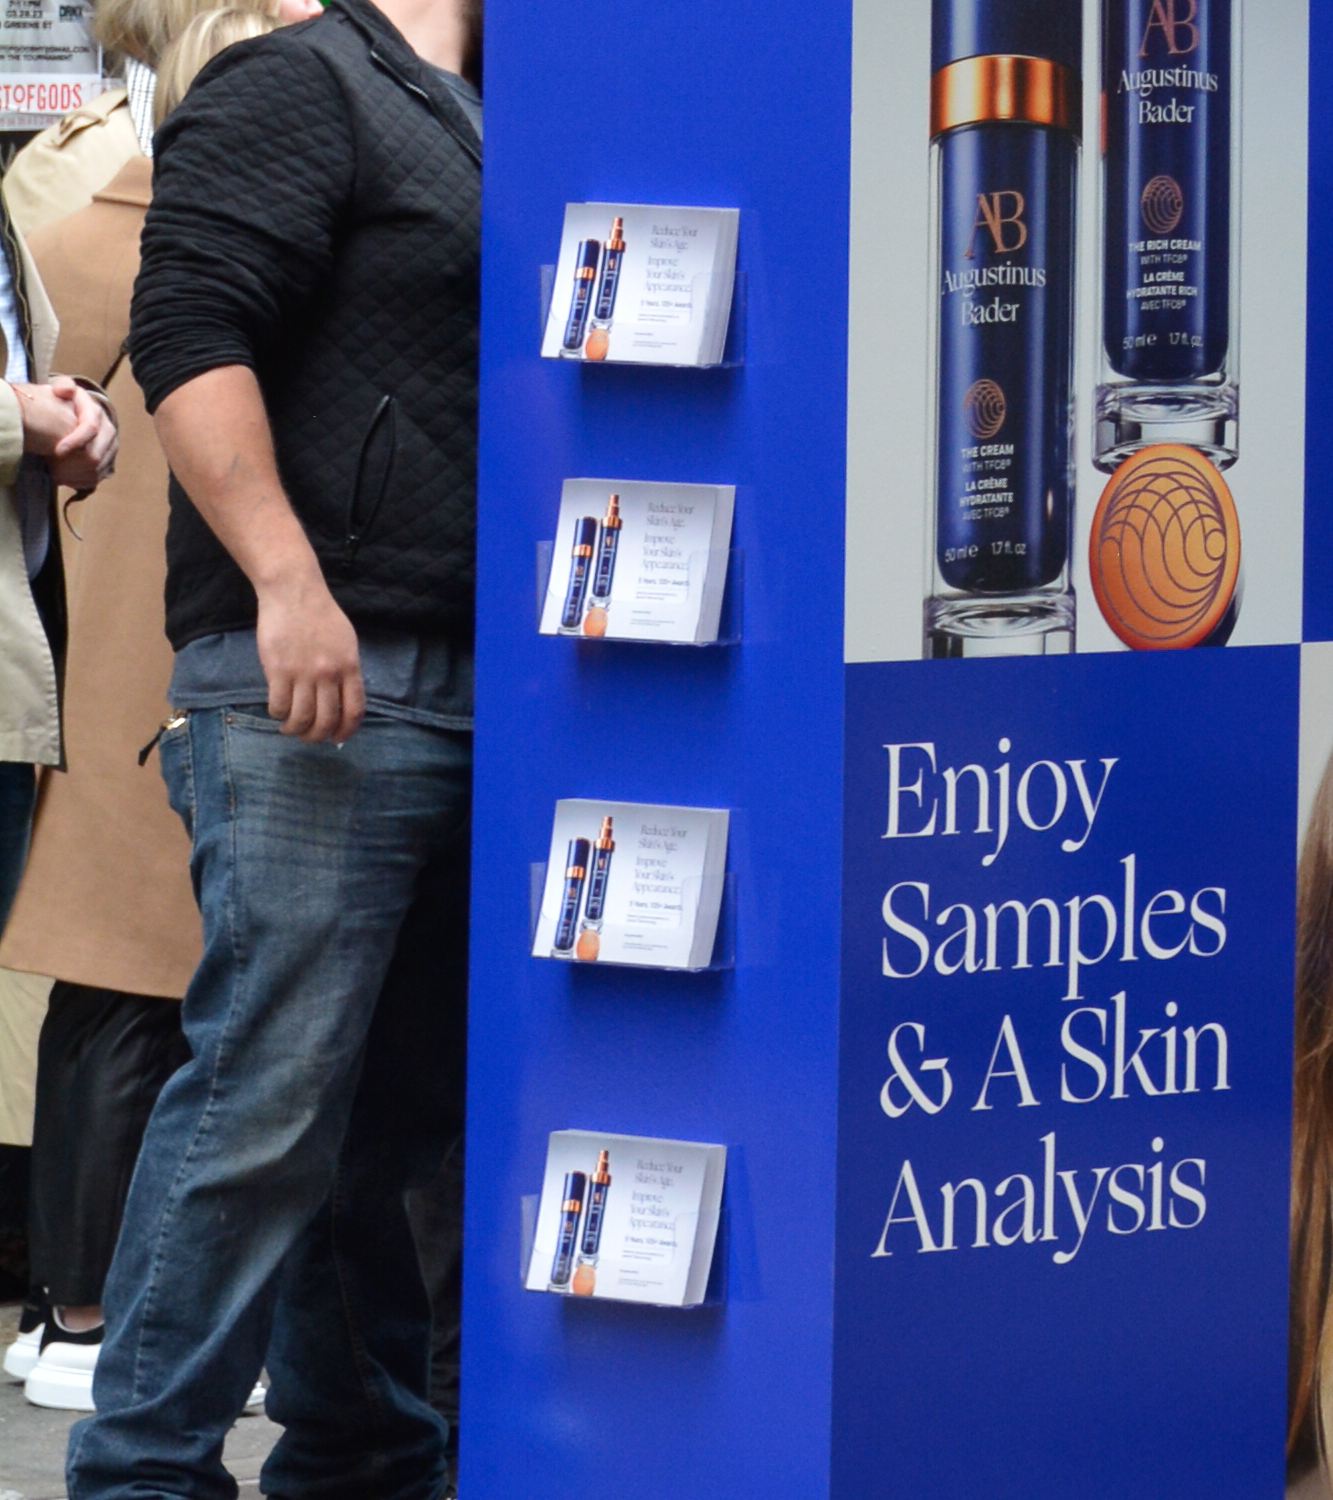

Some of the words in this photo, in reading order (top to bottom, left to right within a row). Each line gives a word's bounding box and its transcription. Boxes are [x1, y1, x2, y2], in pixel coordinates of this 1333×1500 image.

[1117, 64, 1219, 96] Augustinus
[1138, 99, 1195, 124] Bader
[964, 190, 1028, 260] AB
[1147, 240, 1168, 251] RICH
[1170, 239, 1201, 251] CREAM
[941, 261, 1046, 297] Augustinus
[1143, 272, 1154, 283] LA
[960, 297, 1019, 327] Bader
[980, 444, 1014, 457] CREAM
[965, 481, 976, 492] LA
[881, 737, 1120, 867] Enjoy
[881, 852, 1227, 1001] Samples
[879, 1021, 953, 1119] &
[971, 1014, 1041, 1111] A
[1060, 990, 1231, 1103] Skin
[870, 1131, 1207, 1265] Analysis
